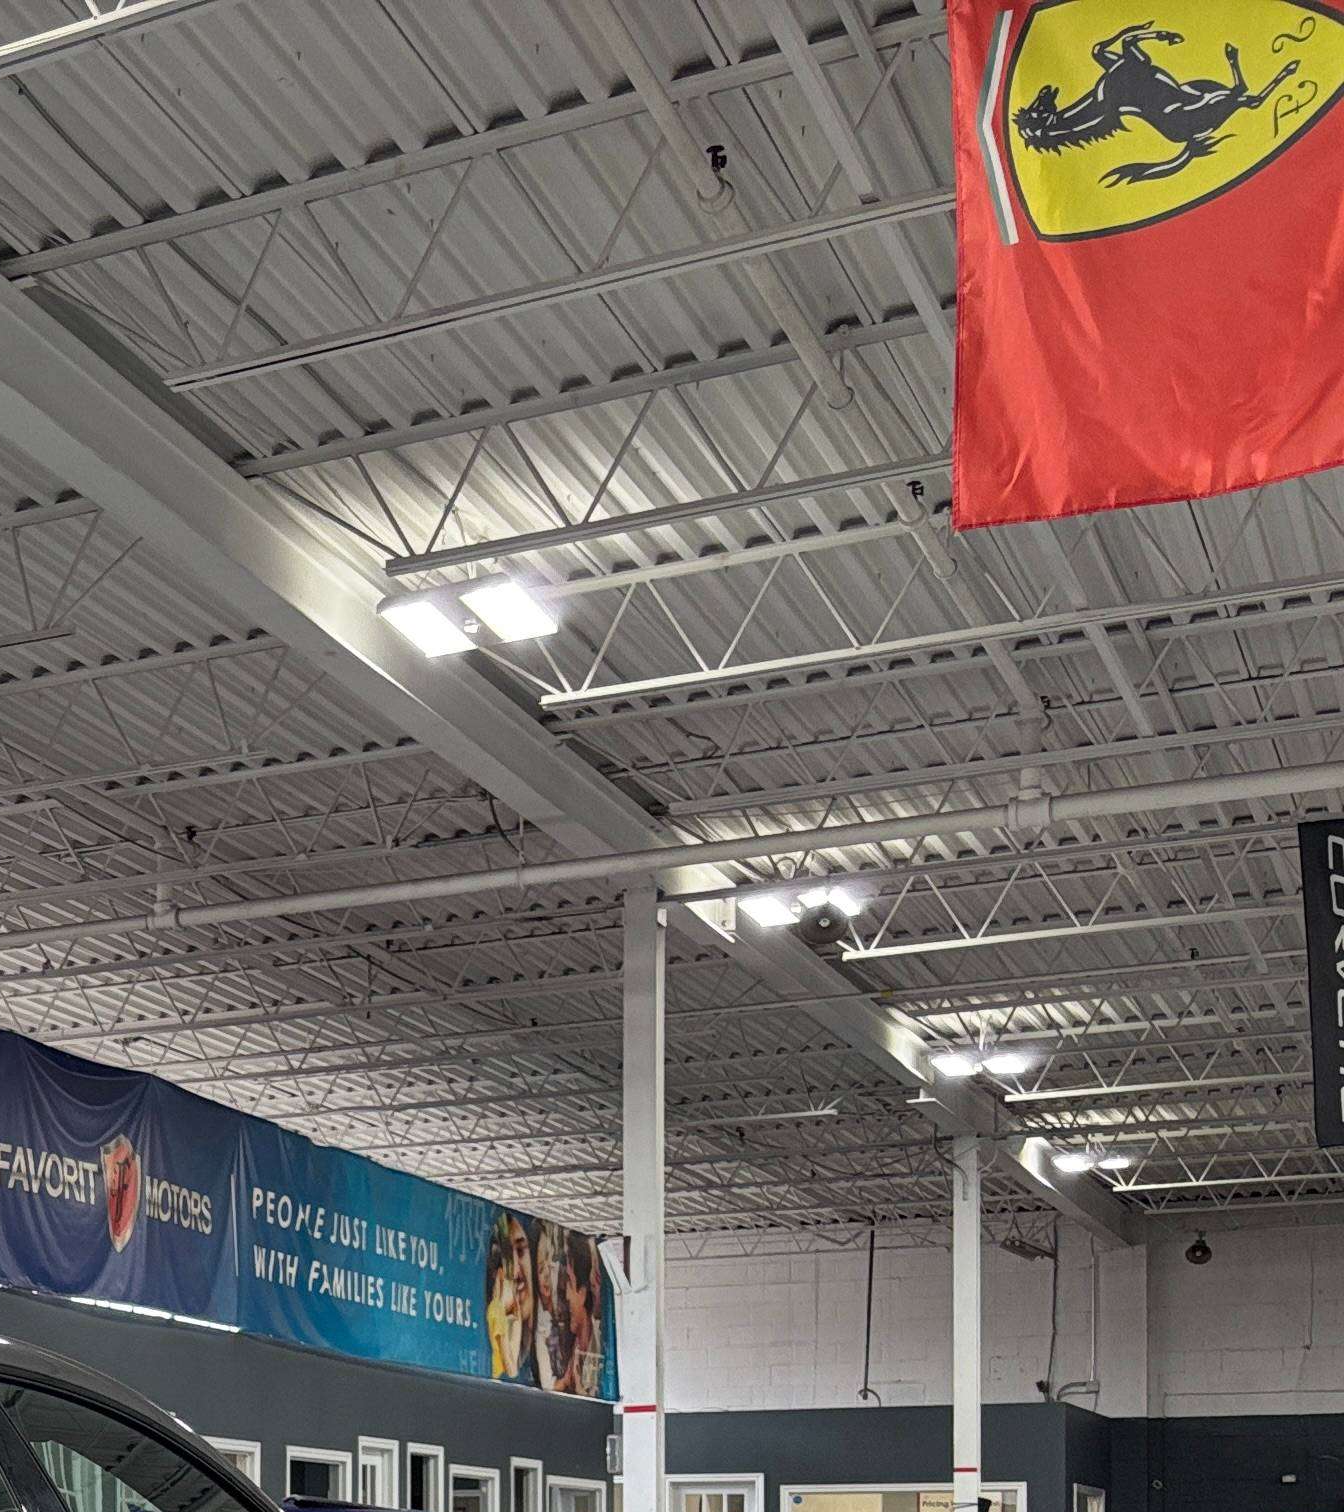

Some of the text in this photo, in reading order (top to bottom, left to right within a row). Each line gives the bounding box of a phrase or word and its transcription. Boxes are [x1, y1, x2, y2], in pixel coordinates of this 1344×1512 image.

[144, 1175, 213, 1236] MOTORS
[330, 1212, 368, 1250] JUST
[375, 1224, 407, 1261] LIKE
[409, 1232, 444, 1275] YOU,
[253, 1245, 479, 1329] WITH FAMILIES LIKE YOURS.
[921, 1500, 950, 1509] Pricing
